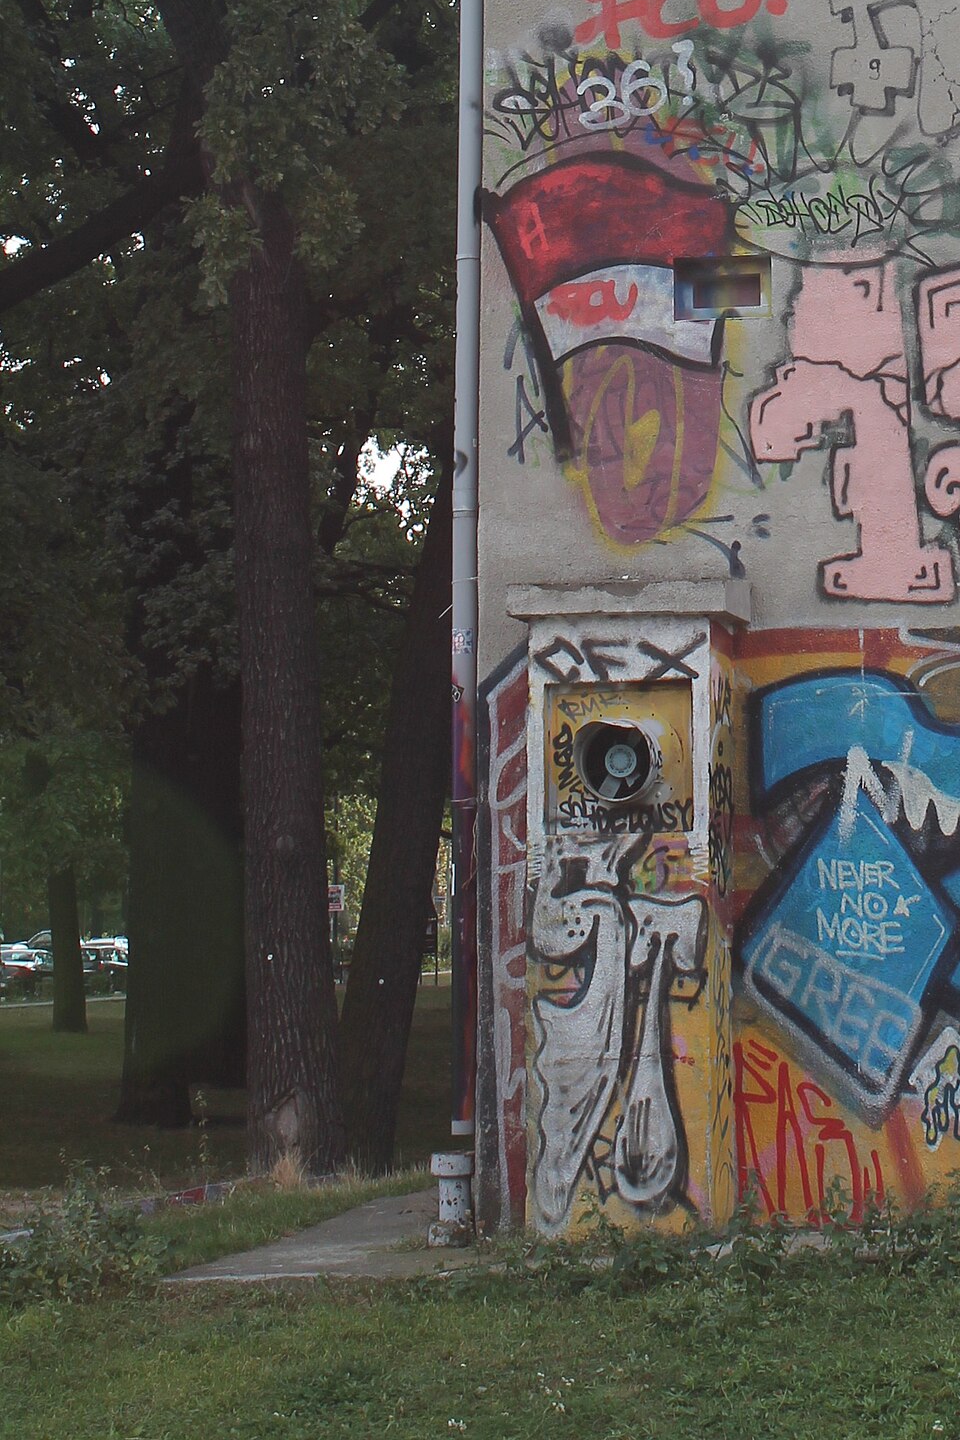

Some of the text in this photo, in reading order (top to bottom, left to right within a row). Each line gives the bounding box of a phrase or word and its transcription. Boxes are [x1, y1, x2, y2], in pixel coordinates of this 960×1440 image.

[817, 858, 900, 892] NEVER
[841, 892, 888, 920] NO
[816, 907, 905, 954] MORE
